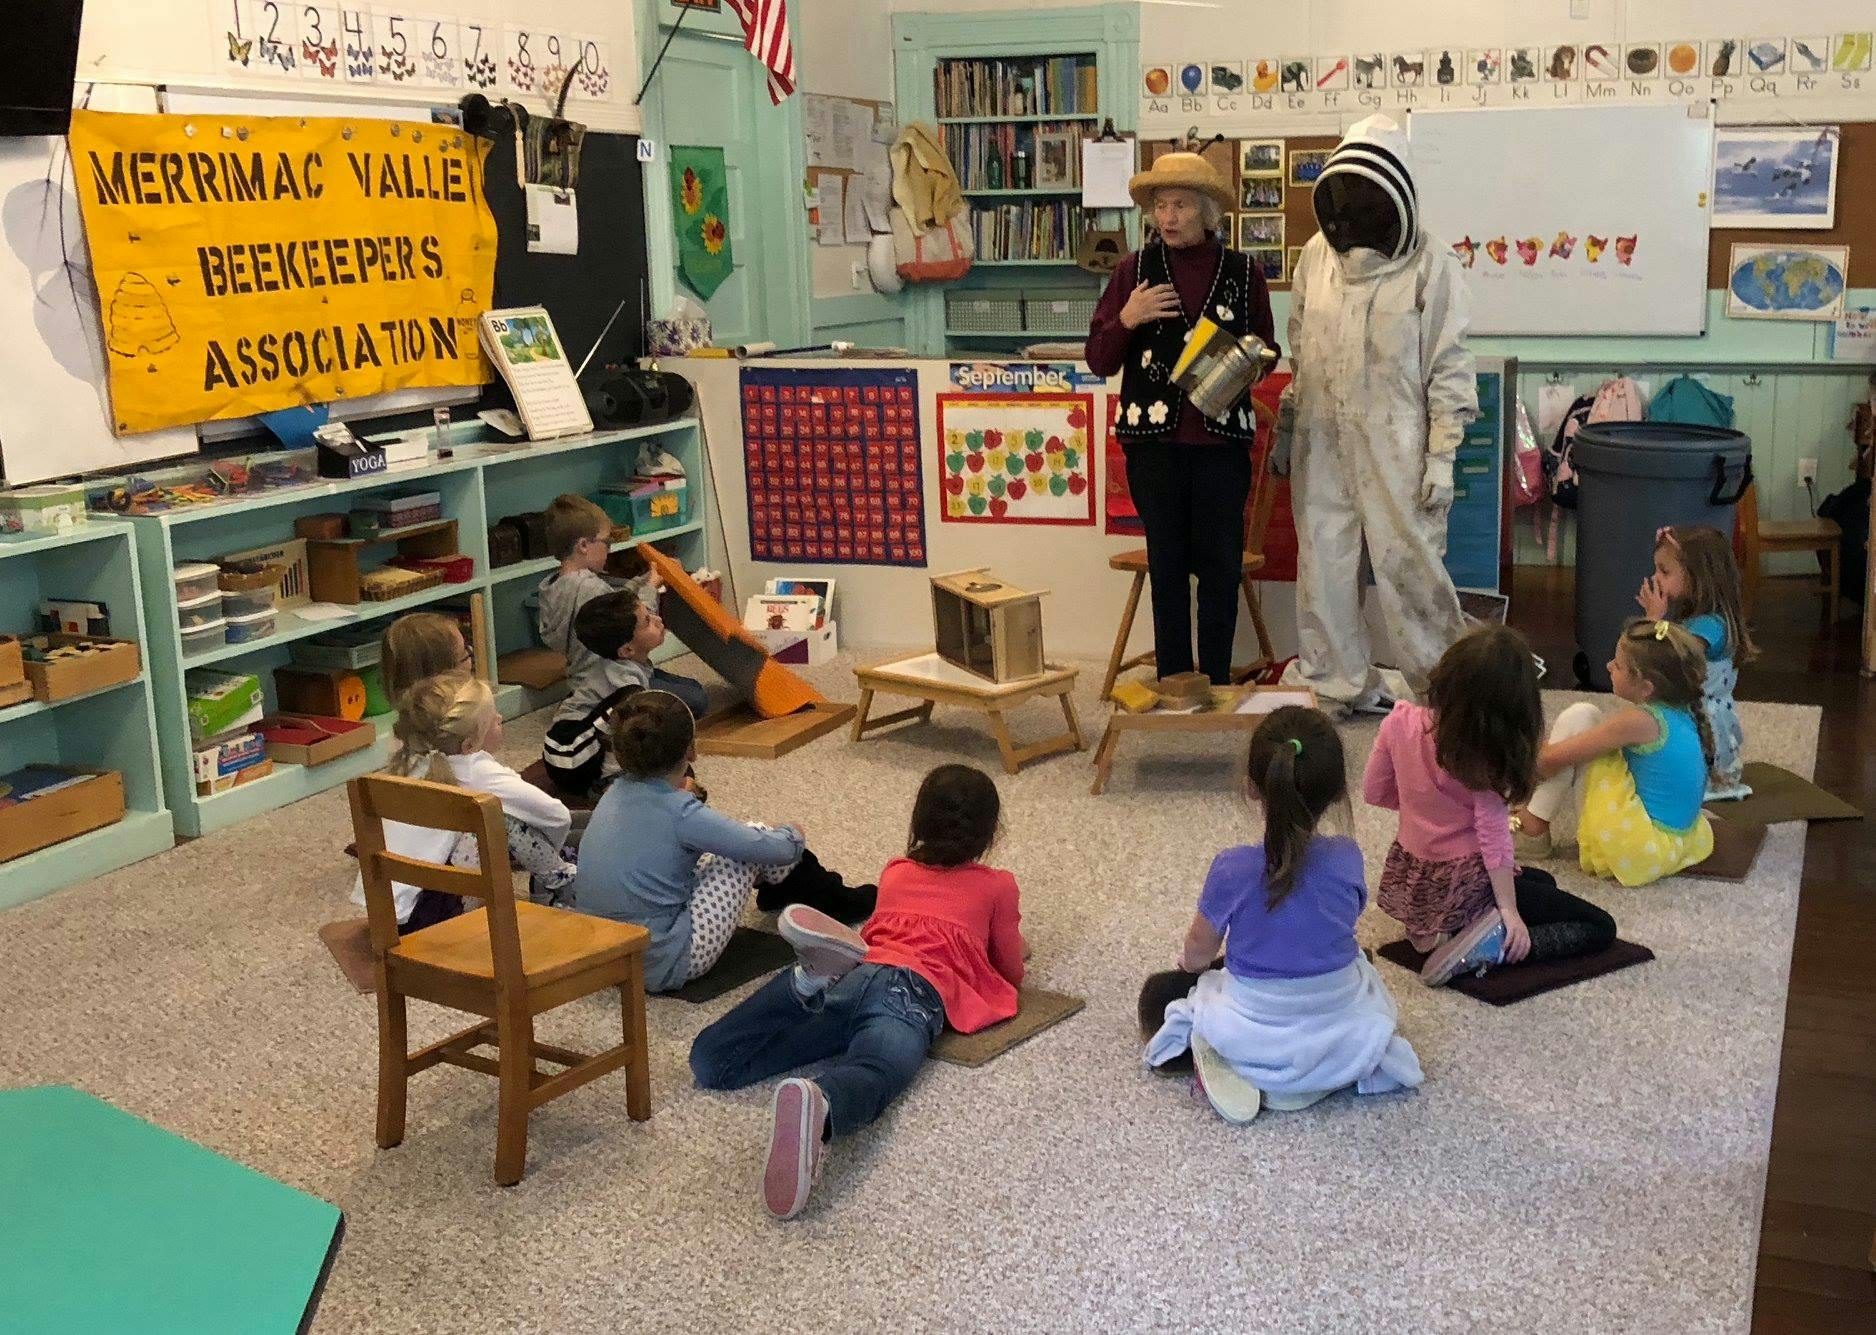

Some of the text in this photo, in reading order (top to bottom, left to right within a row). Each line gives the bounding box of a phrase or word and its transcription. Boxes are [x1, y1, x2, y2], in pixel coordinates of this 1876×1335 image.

[263, 2, 282, 44] 2
[304, 6, 323, 47] 3
[343, 11, 363, 51] 4
[390, 17, 407, 56] 5
[431, 22, 447, 59] 6
[469, 26, 482, 62] 7
[518, 32, 531, 67] 8
[548, 35, 562, 70] 9
[578, 40, 599, 75] 10
[1148, 99, 1169, 113] Aa
[1181, 98, 1203, 113] Bb
[1252, 95, 1273, 110] Dd
[1288, 94, 1305, 109] Ee
[1324, 92, 1340, 106] Ff
[1358, 91, 1382, 109] Gg
[1472, 85, 1487, 105] Jj
[1512, 85, 1530, 99] Kk
[1553, 84, 1568, 98] Ll
[1586, 84, 1616, 97] Mm
[1631, 82, 1651, 96] Nn
[1711, 77, 1733, 98] Pp
[1750, 77, 1776, 96] Qq
[1797, 75, 1817, 91] Rr
[639, 141, 651, 157] N
[88, 150, 475, 205] MERRIMAC VALLE
[197, 236, 443, 297] BEEKEEPERS
[491, 319, 508, 332] Bb
[204, 317, 459, 391] ASSOCIATION
[958, 365, 1067, 390] September
[352, 454, 386, 473] YOGA
